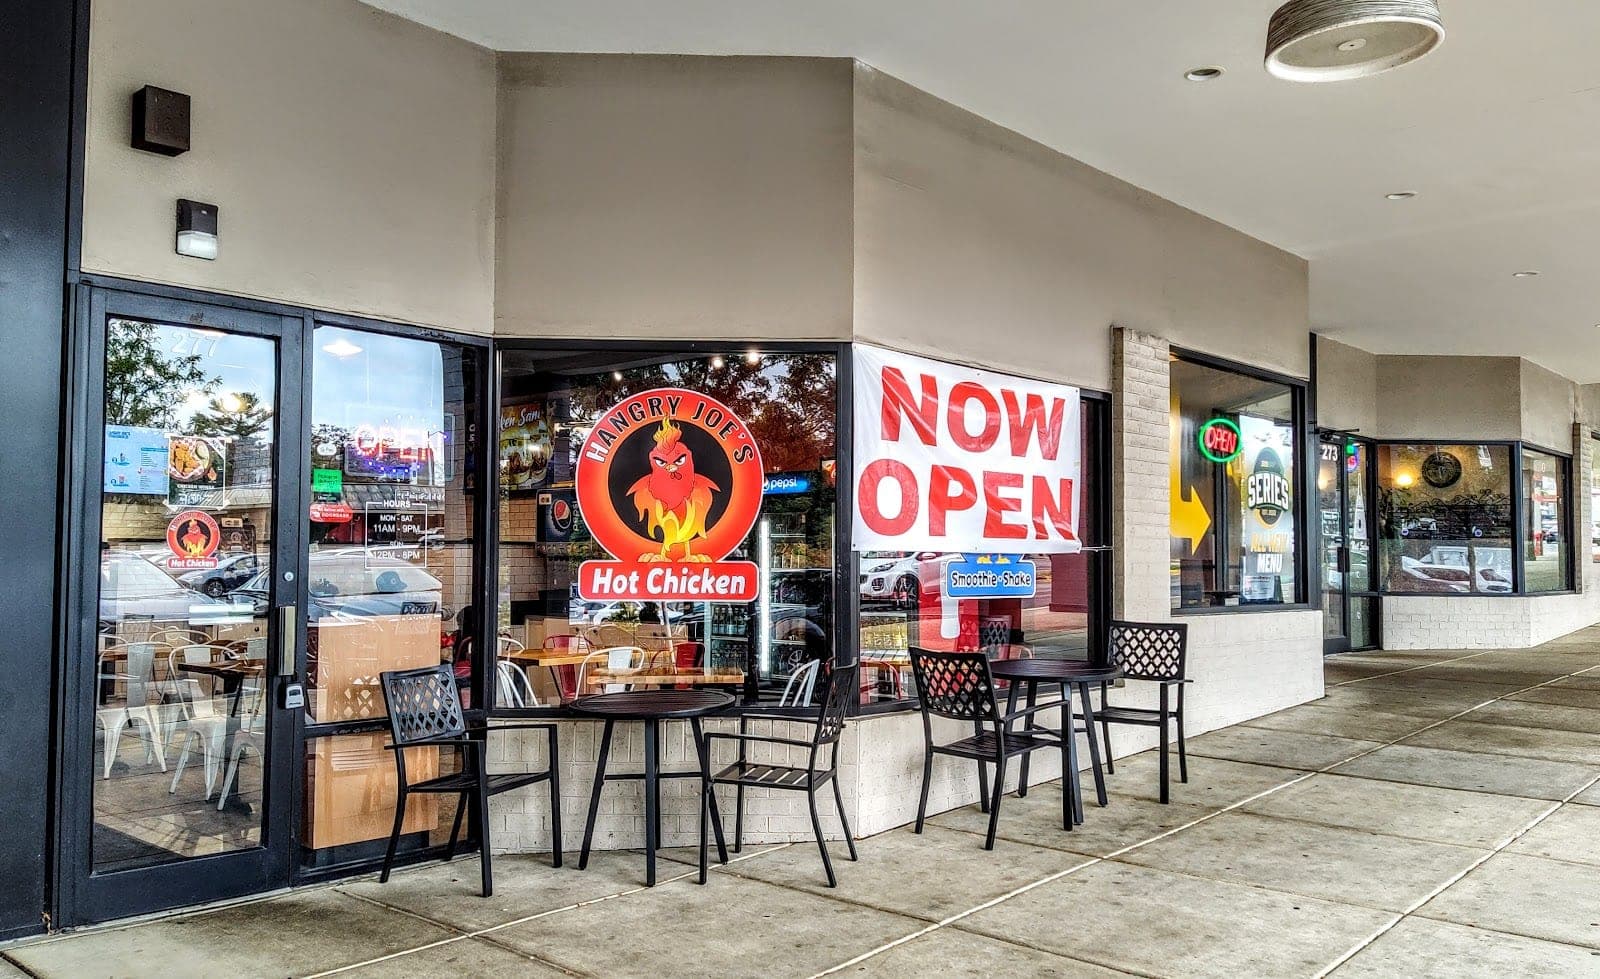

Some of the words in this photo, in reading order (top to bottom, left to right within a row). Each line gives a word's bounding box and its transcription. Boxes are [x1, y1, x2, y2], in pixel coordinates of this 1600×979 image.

[881, 365, 1066, 460] NOW
[586, 395, 682, 463] HANGRY
[692, 402, 755, 464] JOE'S
[1204, 427, 1237, 453] OPEN
[1321, 445, 1338, 461] 273
[771, 477, 797, 490] pepsi
[1248, 472, 1289, 510] SERIES
[384, 500, 411, 508] HOURS
[858, 458, 1076, 540] OPEN
[374, 524, 395, 532] 11AM
[402, 525, 420, 533] 9PM
[171, 559, 185, 568] Hot
[186, 559, 214, 568] Chicken
[373, 551, 395, 559] 12PM
[1257, 553, 1282, 573] MENU
[592, 568, 639, 594] Hot
[647, 567, 746, 594] Chicken
[952, 571, 997, 586] Smoothie
[1003, 571, 1031, 586] Shake
